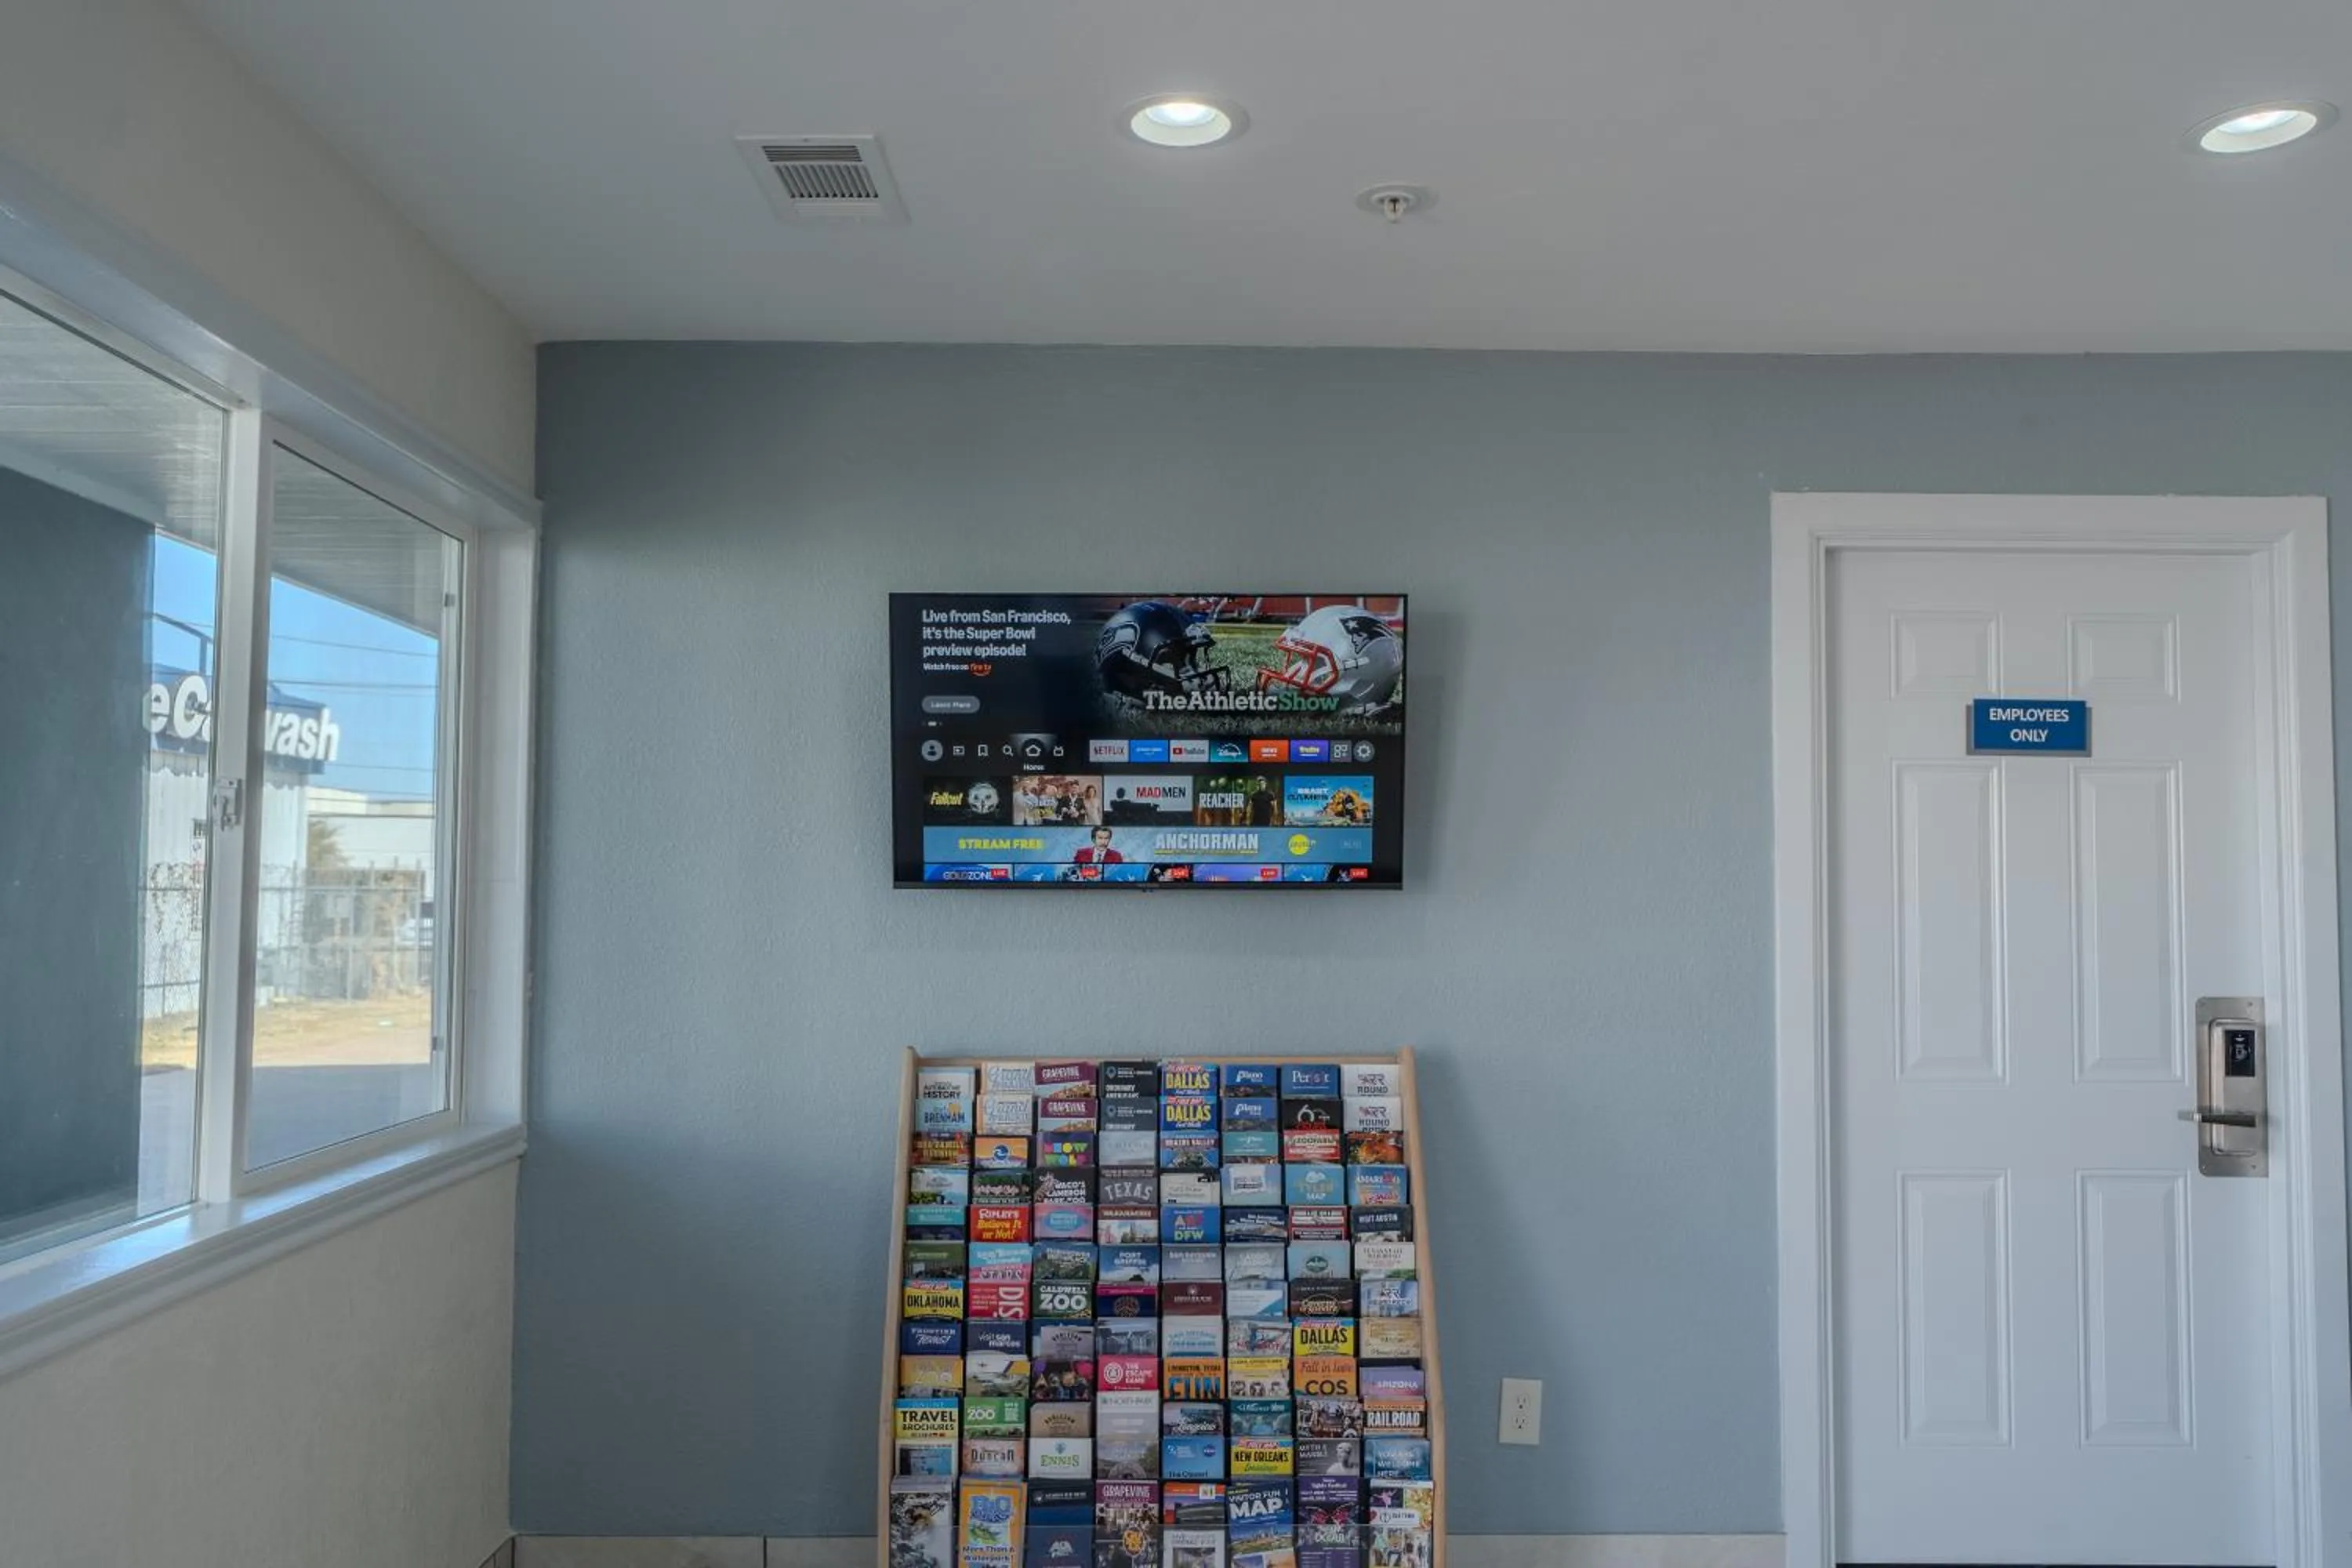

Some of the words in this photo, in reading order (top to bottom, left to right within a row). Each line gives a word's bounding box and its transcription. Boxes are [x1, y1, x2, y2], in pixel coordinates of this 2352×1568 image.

[922, 609, 947, 622] Live
[949, 609, 980, 622] from
[982, 609, 1006, 622] San
[1008, 609, 1071, 624] Francisco,
[923, 627, 941, 639] it's
[944, 627, 964, 639] the
[967, 627, 1004, 641] Super
[1006, 627, 1035, 639] Bowl
[923, 645, 972, 658] preview
[974, 643, 1026, 658] episode!
[1989, 708, 2069, 722] EMPLOYEES
[2010, 728, 2049, 742] ONLY
[1093, 746, 1125, 756] NETFLIX
[930, 792, 964, 806] Fallout
[1199, 793, 1244, 808] REACHER
[958, 839, 1012, 850] STREAM
[1013, 839, 1044, 850] FREE
[1155, 833, 1258, 850] ANCHORMAN
[1042, 1065, 1080, 1080] GRAPEVINE
[1166, 1073, 1210, 1089] DALLAS
[1047, 1102, 1086, 1113] GRAPEVINE
[1166, 1105, 1211, 1122] DALLAS
[1105, 1181, 1153, 1201] TEXAS
[1173, 1230, 1204, 1241] DFW
[907, 1294, 960, 1308] OKLAHOMA
[1040, 1294, 1087, 1311] ZOO
[1300, 1328, 1348, 1344] DALLAS
[1305, 1380, 1348, 1396] COS
[902, 1410, 956, 1422] TRAVEL
[1367, 1411, 1420, 1427] RAILROAD
[1040, 1454, 1080, 1466] ENNIS
[1234, 1452, 1253, 1462] NEW
[1254, 1451, 1289, 1462] ORLEANS
[1103, 1485, 1150, 1497] GRAPEVINE
[1229, 1497, 1283, 1519] MAP
